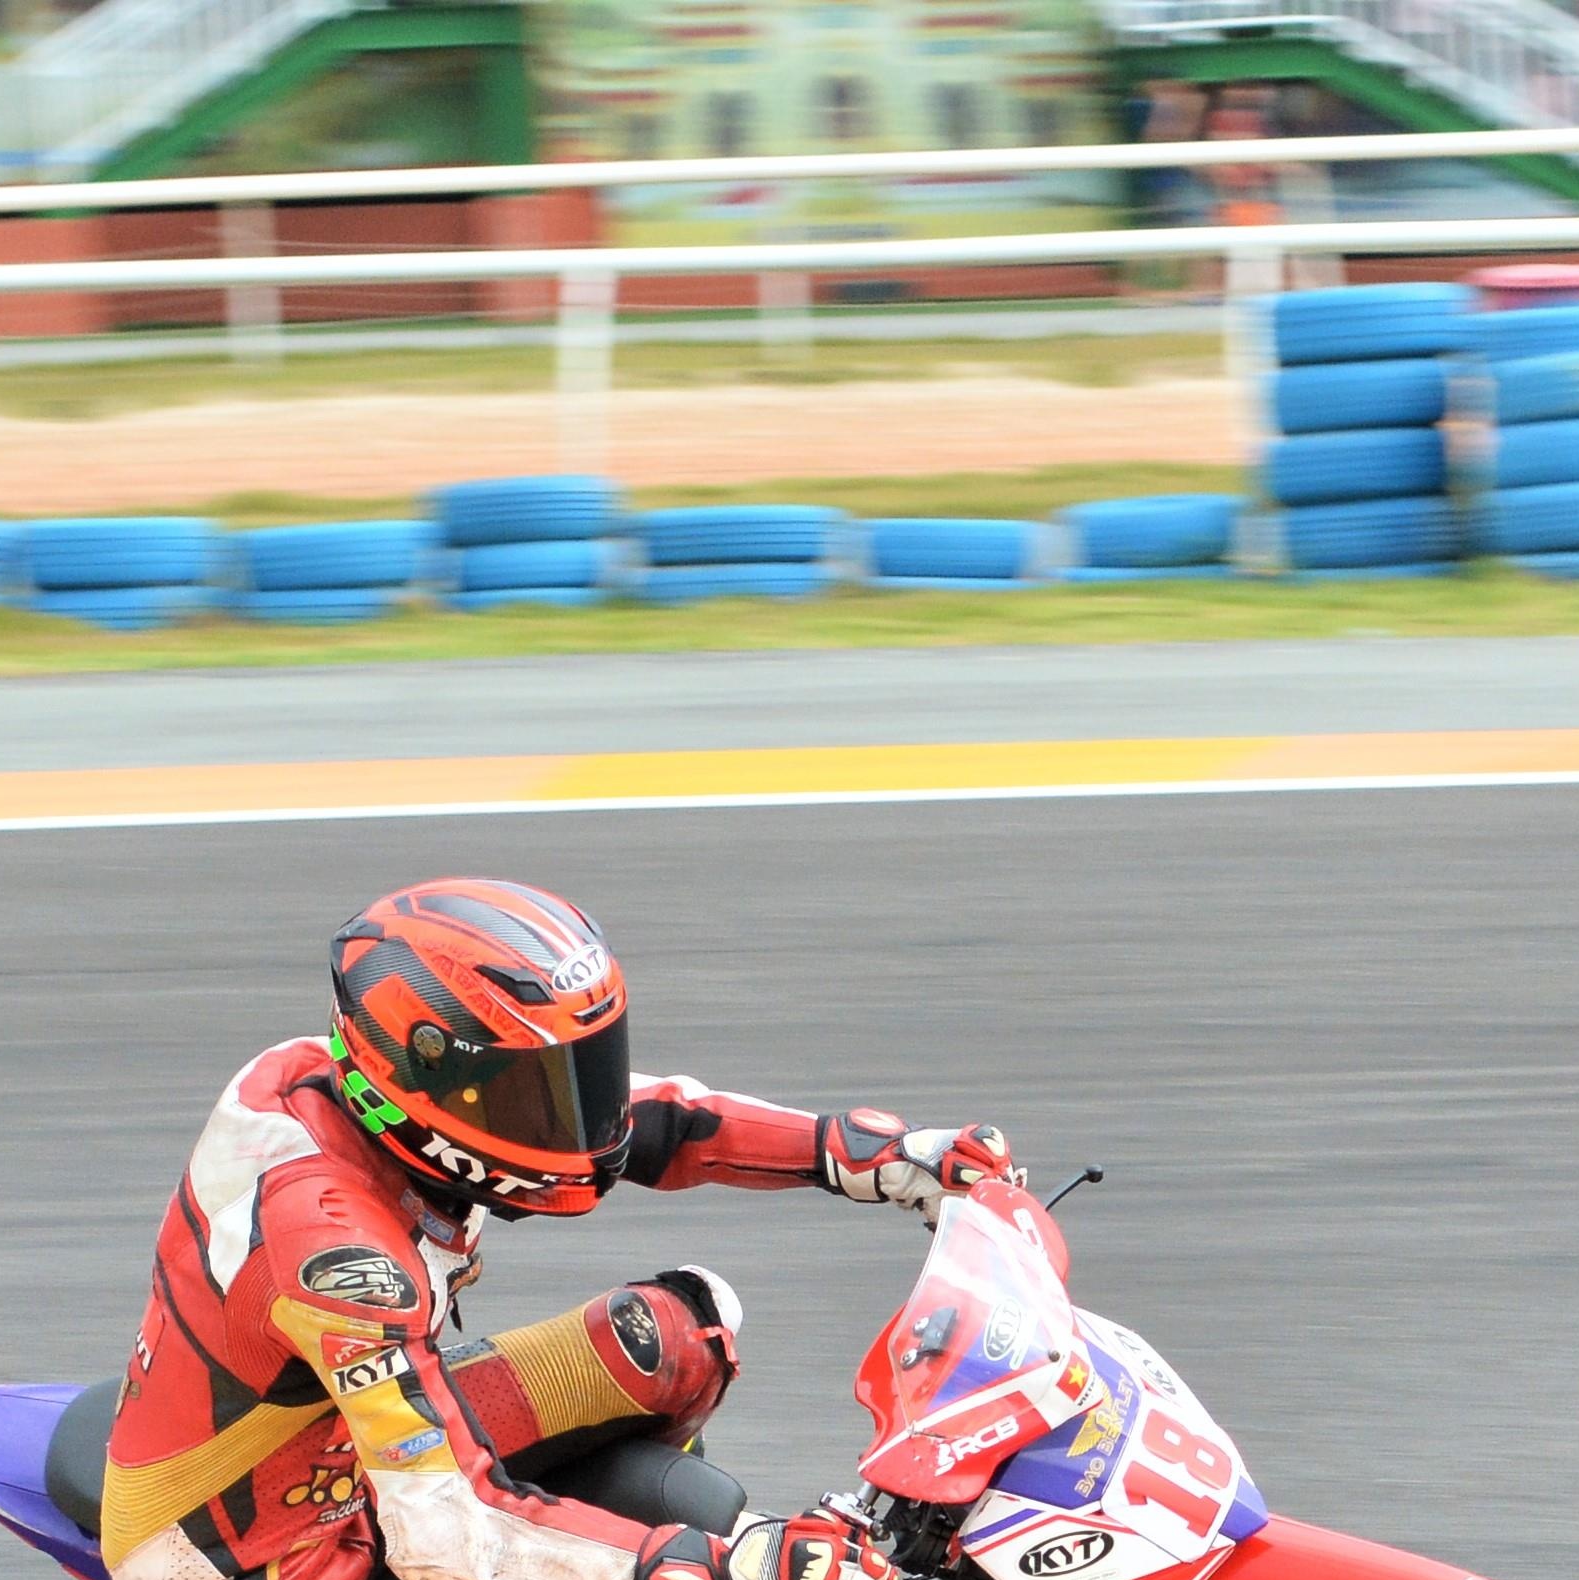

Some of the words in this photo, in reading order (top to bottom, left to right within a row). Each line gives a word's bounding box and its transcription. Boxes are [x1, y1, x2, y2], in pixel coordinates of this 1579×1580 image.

[453, 1039, 484, 1054] KYT
[421, 1131, 545, 1195] KYT
[334, 1349, 399, 1394] KYT
[1074, 1456, 1106, 1498] BAO
[1097, 1372, 1134, 1457] BENTLEY
[1123, 1408, 1232, 1538] 18
[1027, 1534, 1100, 1574] KYT
